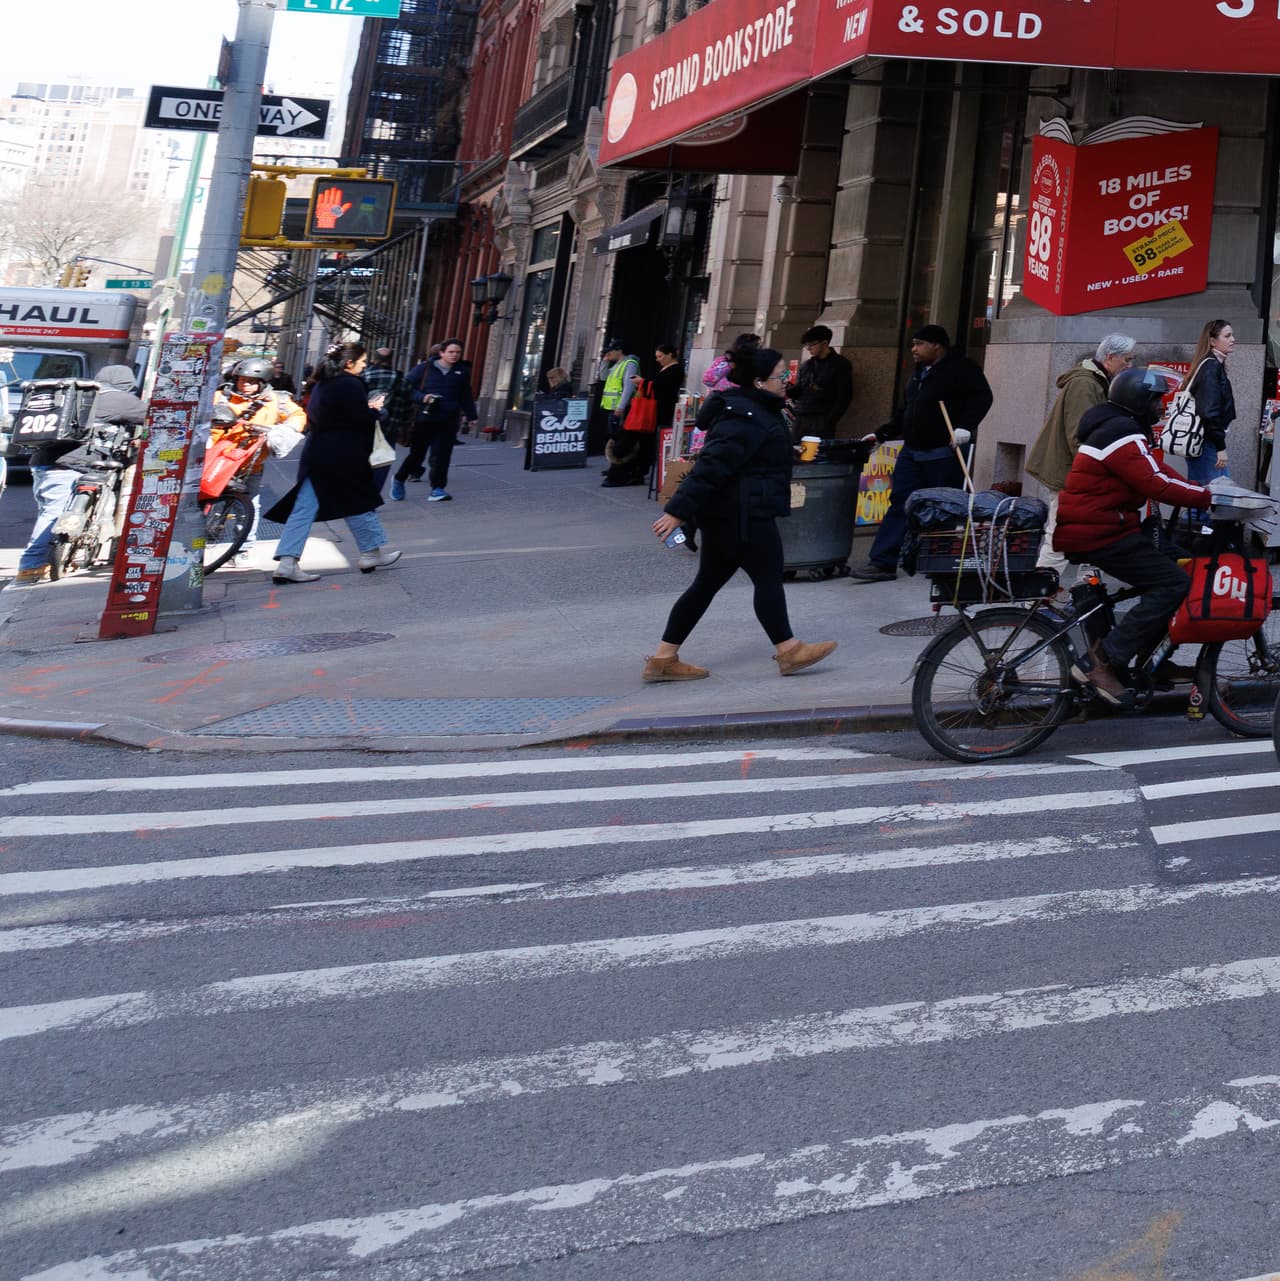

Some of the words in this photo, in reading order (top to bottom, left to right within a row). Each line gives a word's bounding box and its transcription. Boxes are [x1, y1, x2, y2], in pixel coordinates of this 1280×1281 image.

[844, 8, 868, 42] NEW
[898, 6, 923, 33] &
[936, 9, 1042, 39] SOLD
[651, 52, 699, 110] STRAND
[703, 0, 796, 86] BOOKSTORE
[175, 100, 223, 120] ONE
[259, 107, 303, 126] WAY
[1034, 154, 1061, 197] CELEBRATING
[1098, 177, 1121, 196] 18
[1126, 164, 1192, 191] MILES
[1059, 166, 1071, 233] STRAND
[1129, 189, 1161, 210] OF
[1103, 204, 1189, 236] BOOKS!
[1029, 211, 1051, 262] 98
[1132, 237, 1158, 253] STRAND
[1157, 225, 1177, 240] PRICE
[1027, 256, 1049, 281] YEARS!
[1055, 236, 1066, 294] BOOKS
[1134, 247, 1158, 266] 98
[1087, 279, 1113, 292] NEW
[1121, 272, 1149, 284] USED
[1157, 266, 1184, 278] RARE
[20, 414, 58, 434] 202
[536, 431, 584, 443] BEAUTY
[535, 442, 584, 454] SOURCE
[1213, 566, 1247, 602] GH
